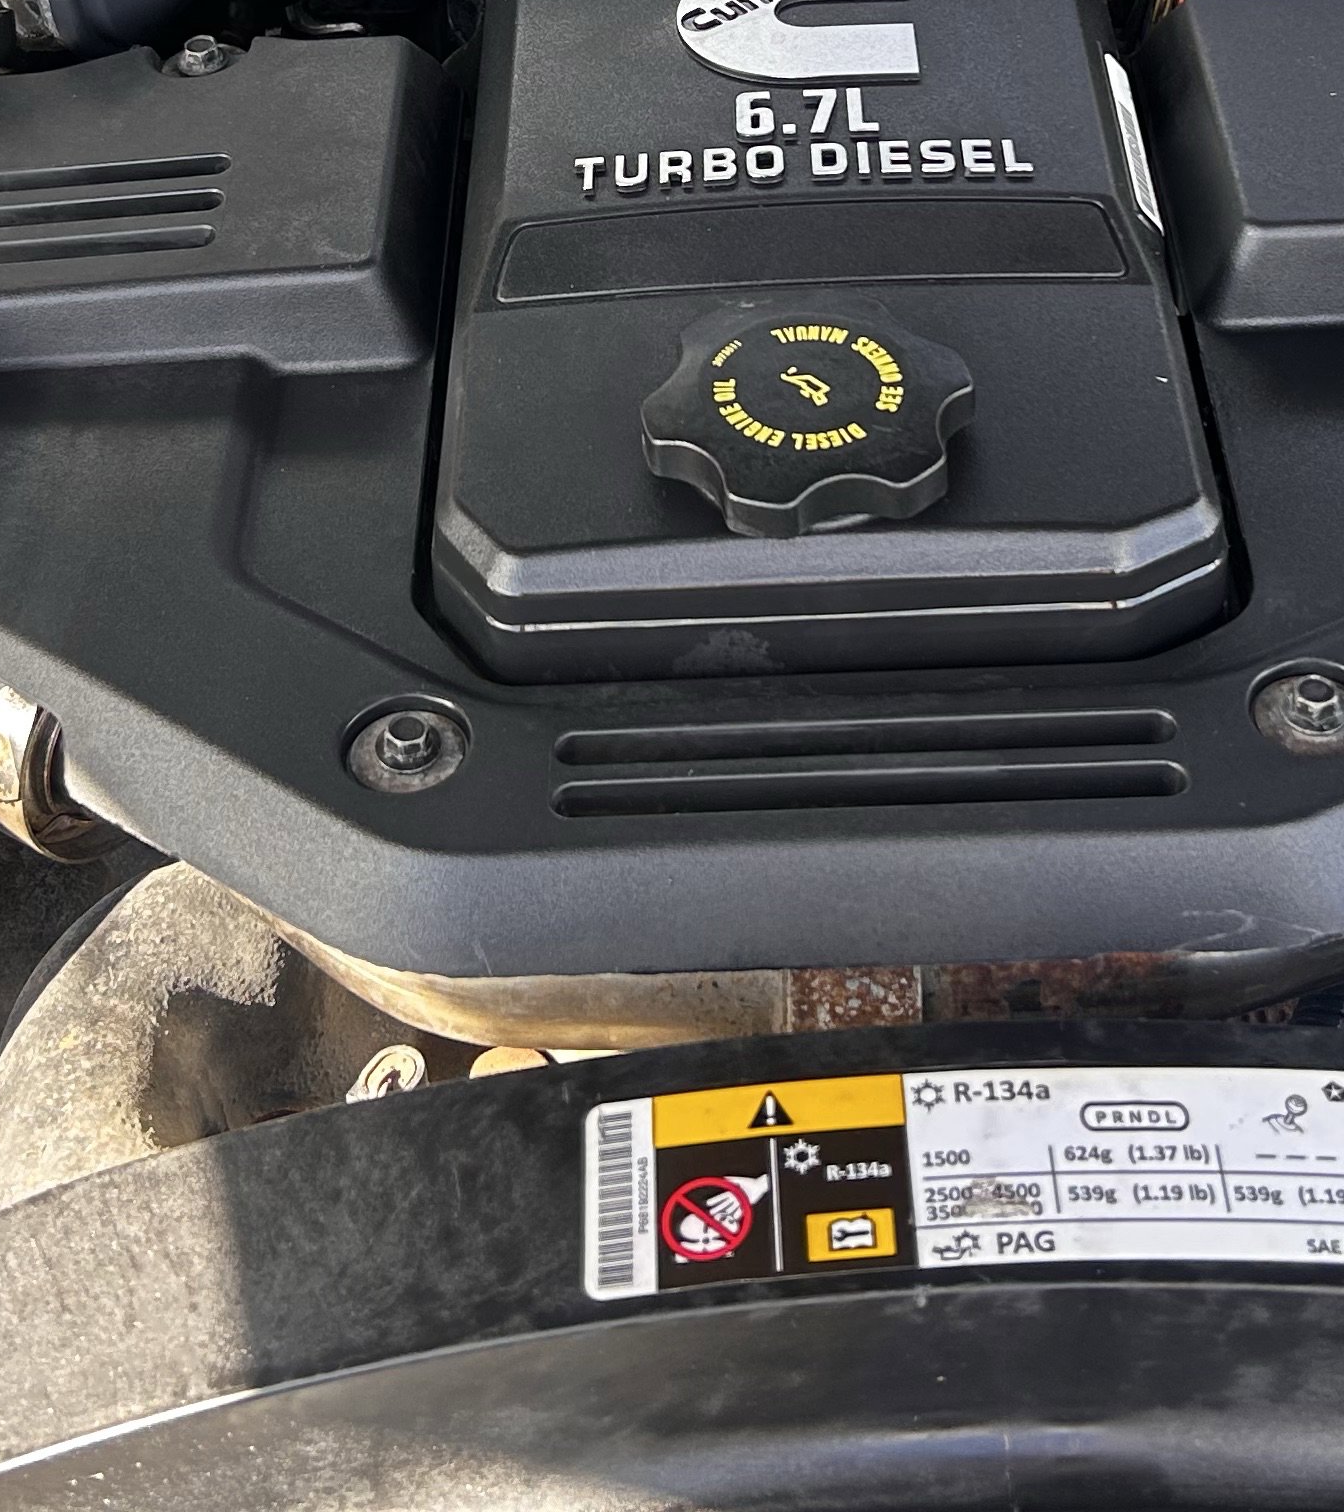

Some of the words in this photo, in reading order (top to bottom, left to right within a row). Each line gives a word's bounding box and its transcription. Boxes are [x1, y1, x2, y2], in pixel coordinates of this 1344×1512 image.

[735, 88, 881, 141] 6.7L
[574, 144, 785, 192] TURBO
[810, 138, 1035, 179] DIESEL
[770, 325, 850, 345] MANUAL
[712, 378, 737, 403] OIL
[875, 385, 905, 414] SEE
[718, 402, 787, 448] ENGINE
[791, 421, 868, 451] DIESEL
[953, 1079, 1051, 1104] R-134a
[922, 1148, 972, 1168] 1500
[1063, 1144, 1114, 1165] 624g
[1127, 1143, 1178, 1165] (1.37
[1182, 1143, 1211, 1165] lb)
[825, 1161, 894, 1183] R-134a
[924, 1185, 973, 1204] 2500
[1067, 1184, 1118, 1205] 539g
[1132, 1183, 1184, 1205] (1.19
[1187, 1183, 1216, 1206] lb)
[1232, 1185, 1285, 1207] 539g
[926, 1203, 975, 1222] 350
[996, 1229, 1057, 1255] PAG
[1306, 1238, 1342, 1256] SAE
